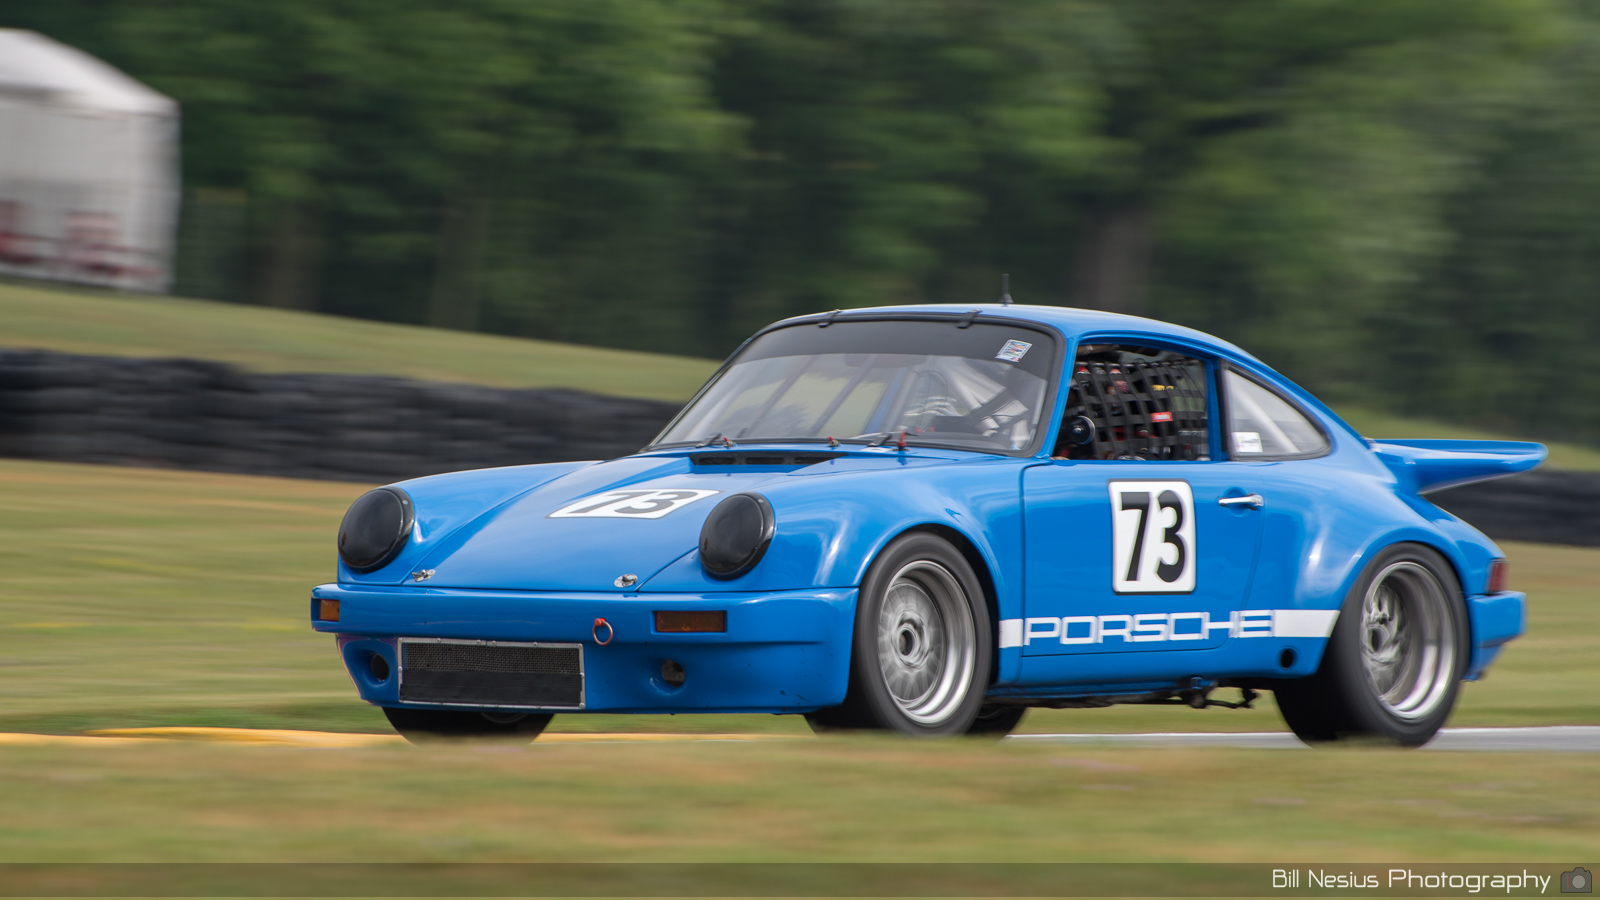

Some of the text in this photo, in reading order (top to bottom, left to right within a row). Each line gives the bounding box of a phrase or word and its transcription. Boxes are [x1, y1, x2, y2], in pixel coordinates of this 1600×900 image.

[567, 490, 699, 514] 73
[1119, 489, 1188, 583] 73
[1024, 609, 1274, 646] PORSCHE
